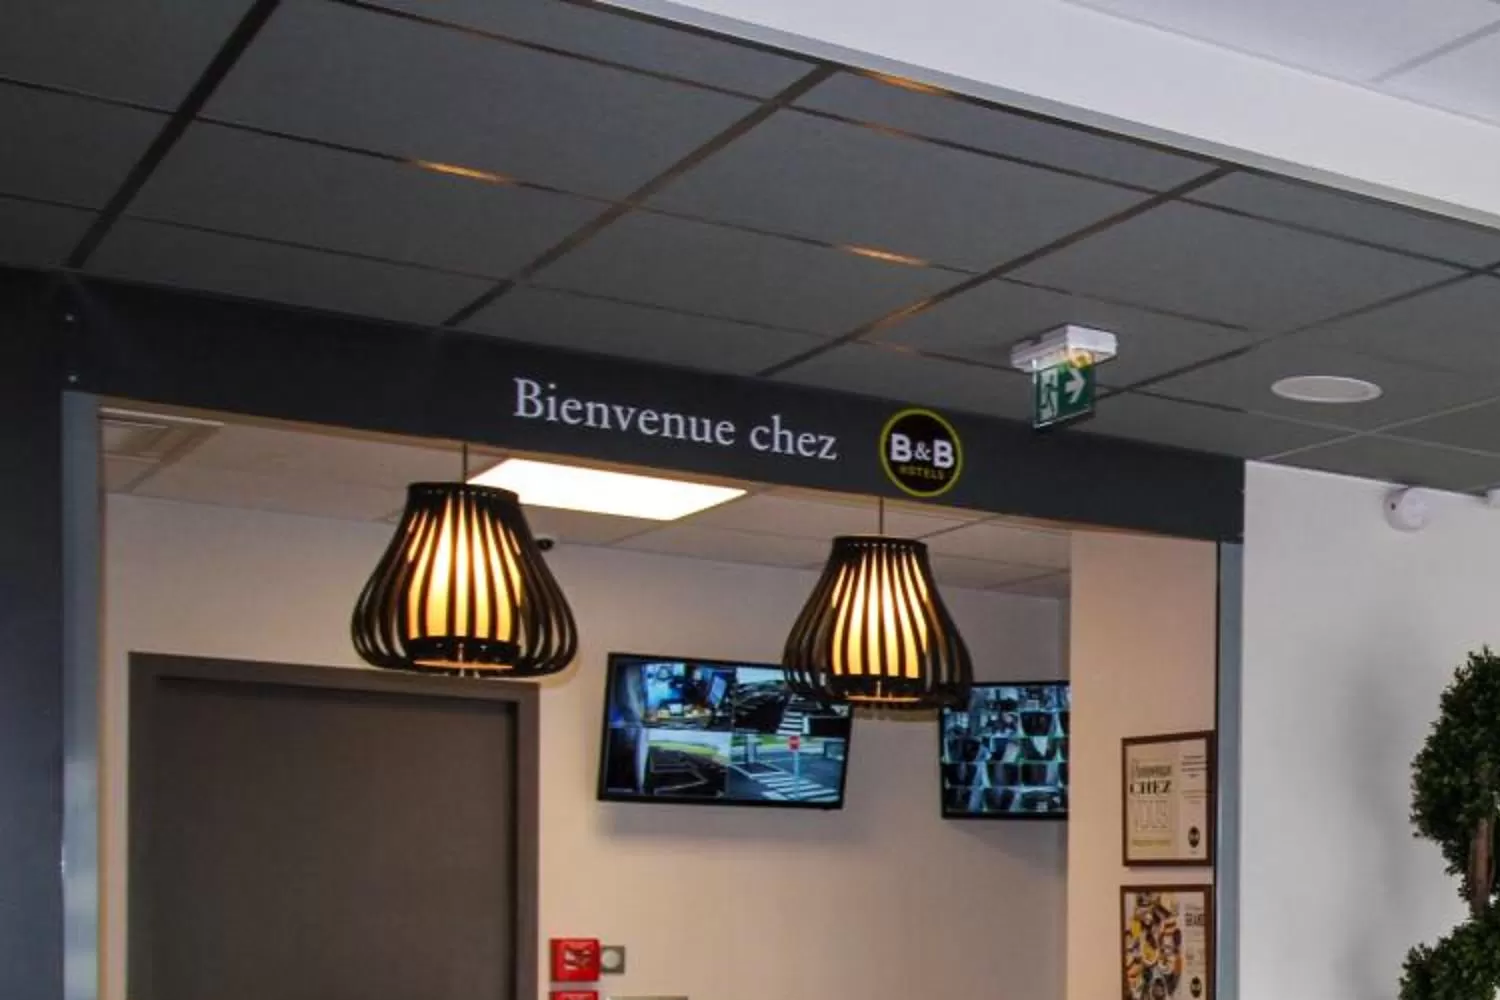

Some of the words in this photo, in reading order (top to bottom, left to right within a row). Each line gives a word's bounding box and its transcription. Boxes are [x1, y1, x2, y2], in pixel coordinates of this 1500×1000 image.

[512, 377, 736, 446] Bienvenue
[749, 413, 837, 461] chez
[890, 432, 955, 469] B&B
[898, 464, 946, 481] HOTELS
